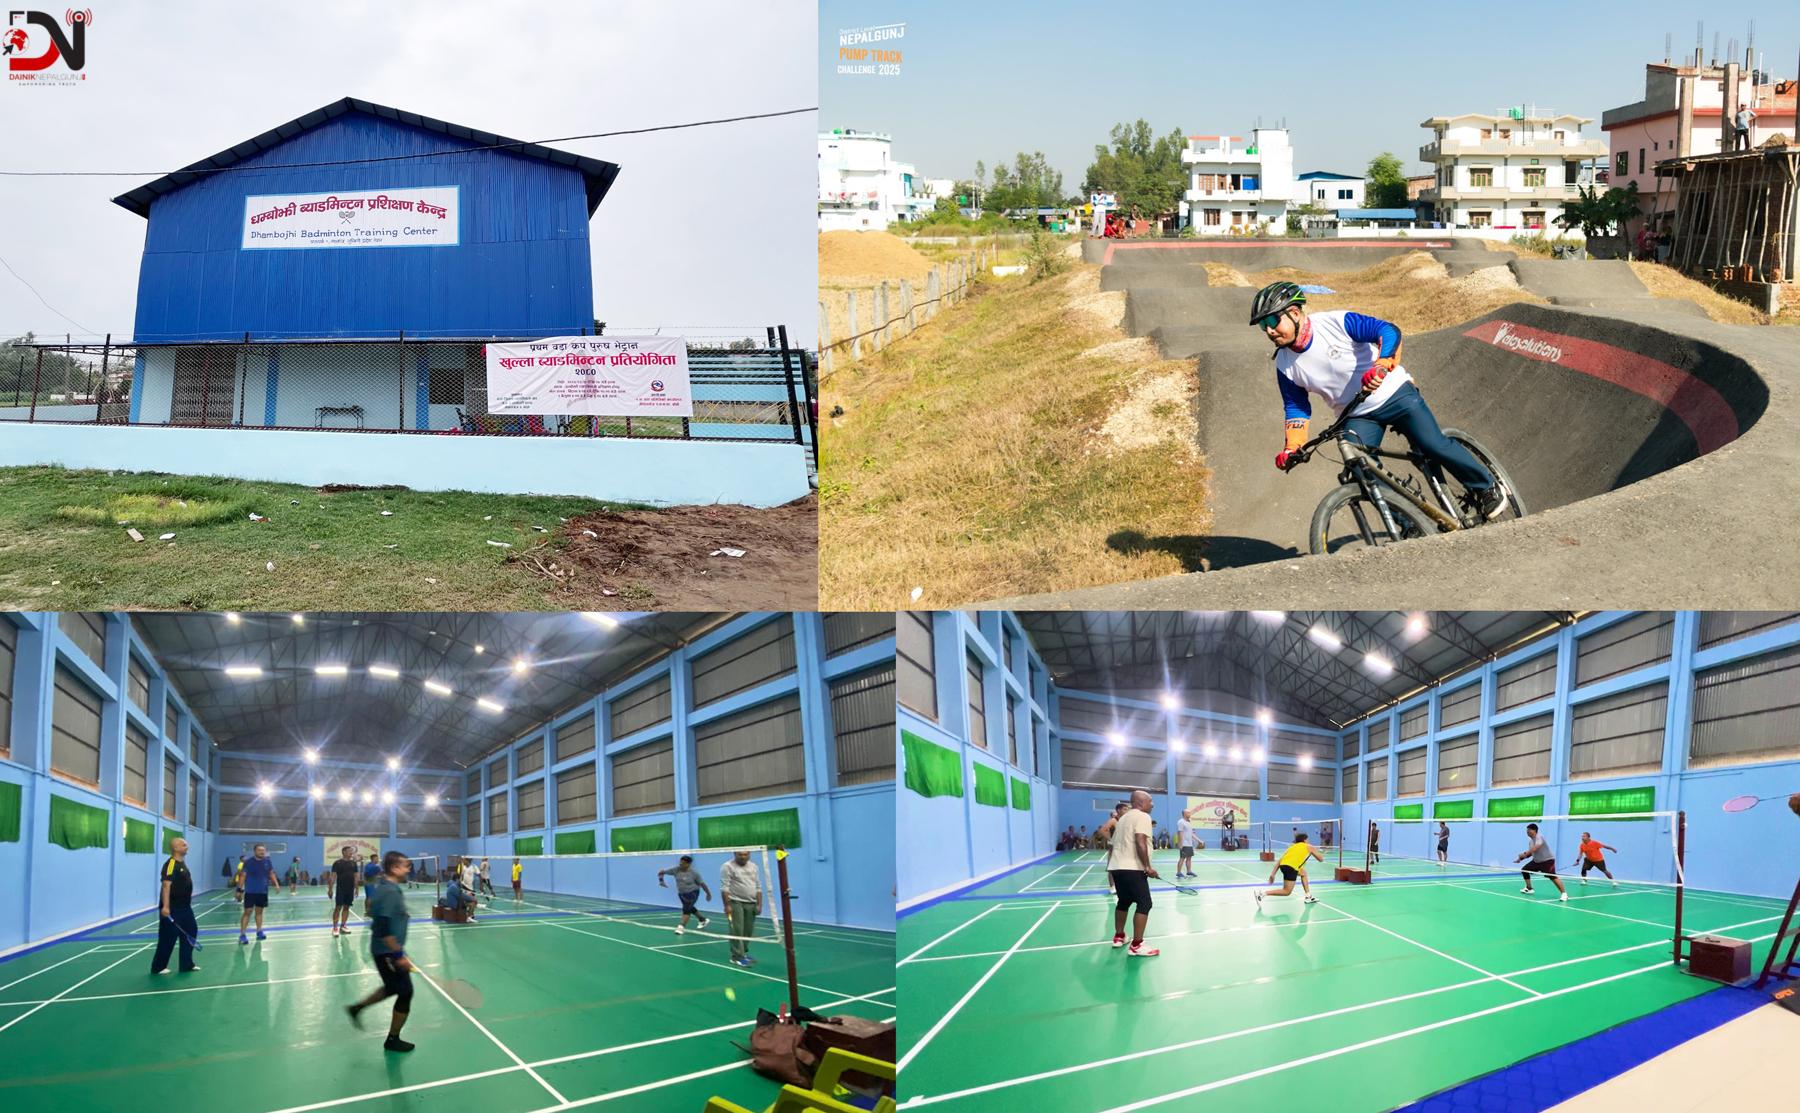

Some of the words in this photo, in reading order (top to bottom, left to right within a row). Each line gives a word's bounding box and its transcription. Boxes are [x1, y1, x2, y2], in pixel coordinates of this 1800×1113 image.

[251, 202, 297, 224] धम्बोझी
[300, 196, 365, 213] ब्याडमिन्टन
[367, 195, 414, 211] प्रशिक्षण
[416, 200, 447, 219] केन्द्र
[251, 230, 297, 239] Dhambojhi
[301, 229, 351, 238] Badminton
[354, 227, 398, 237] Training
[403, 226, 438, 236] Center
[530, 343, 548, 352] प्रथम
[571, 342, 586, 350] कप
[499, 355, 534, 370] खुल्ला
[610, 351, 676, 367] प्रतियोगिता
